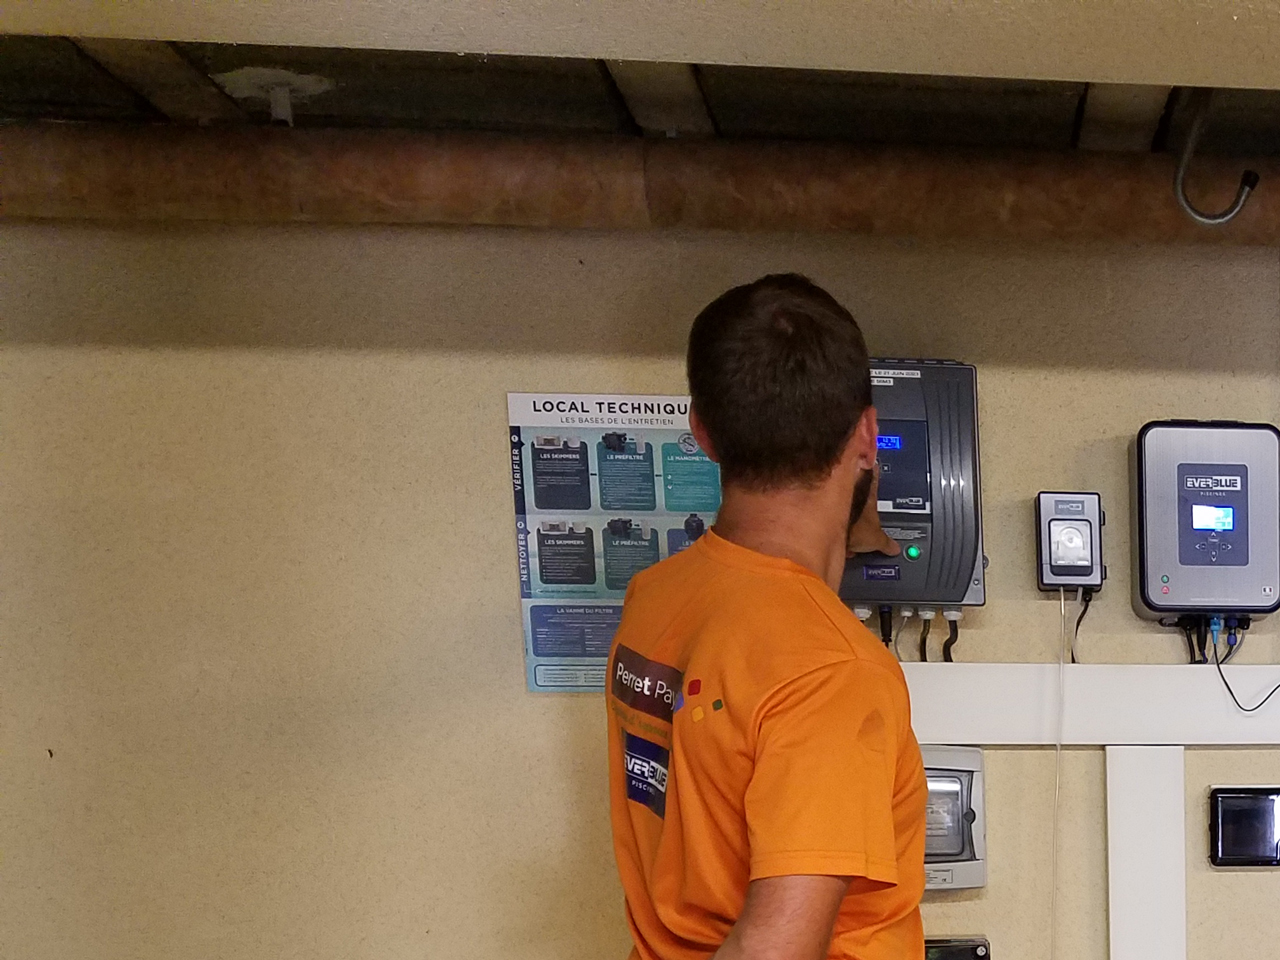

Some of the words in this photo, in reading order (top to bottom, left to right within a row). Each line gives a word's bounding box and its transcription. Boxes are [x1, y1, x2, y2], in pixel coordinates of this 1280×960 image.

[532, 400, 590, 413] LOCAL
[595, 401, 688, 415] TECHNIQU
[511, 448, 522, 491] VÉRIFIER
[518, 533, 528, 581] NETTOYER
[615, 662, 651, 696] Perret
